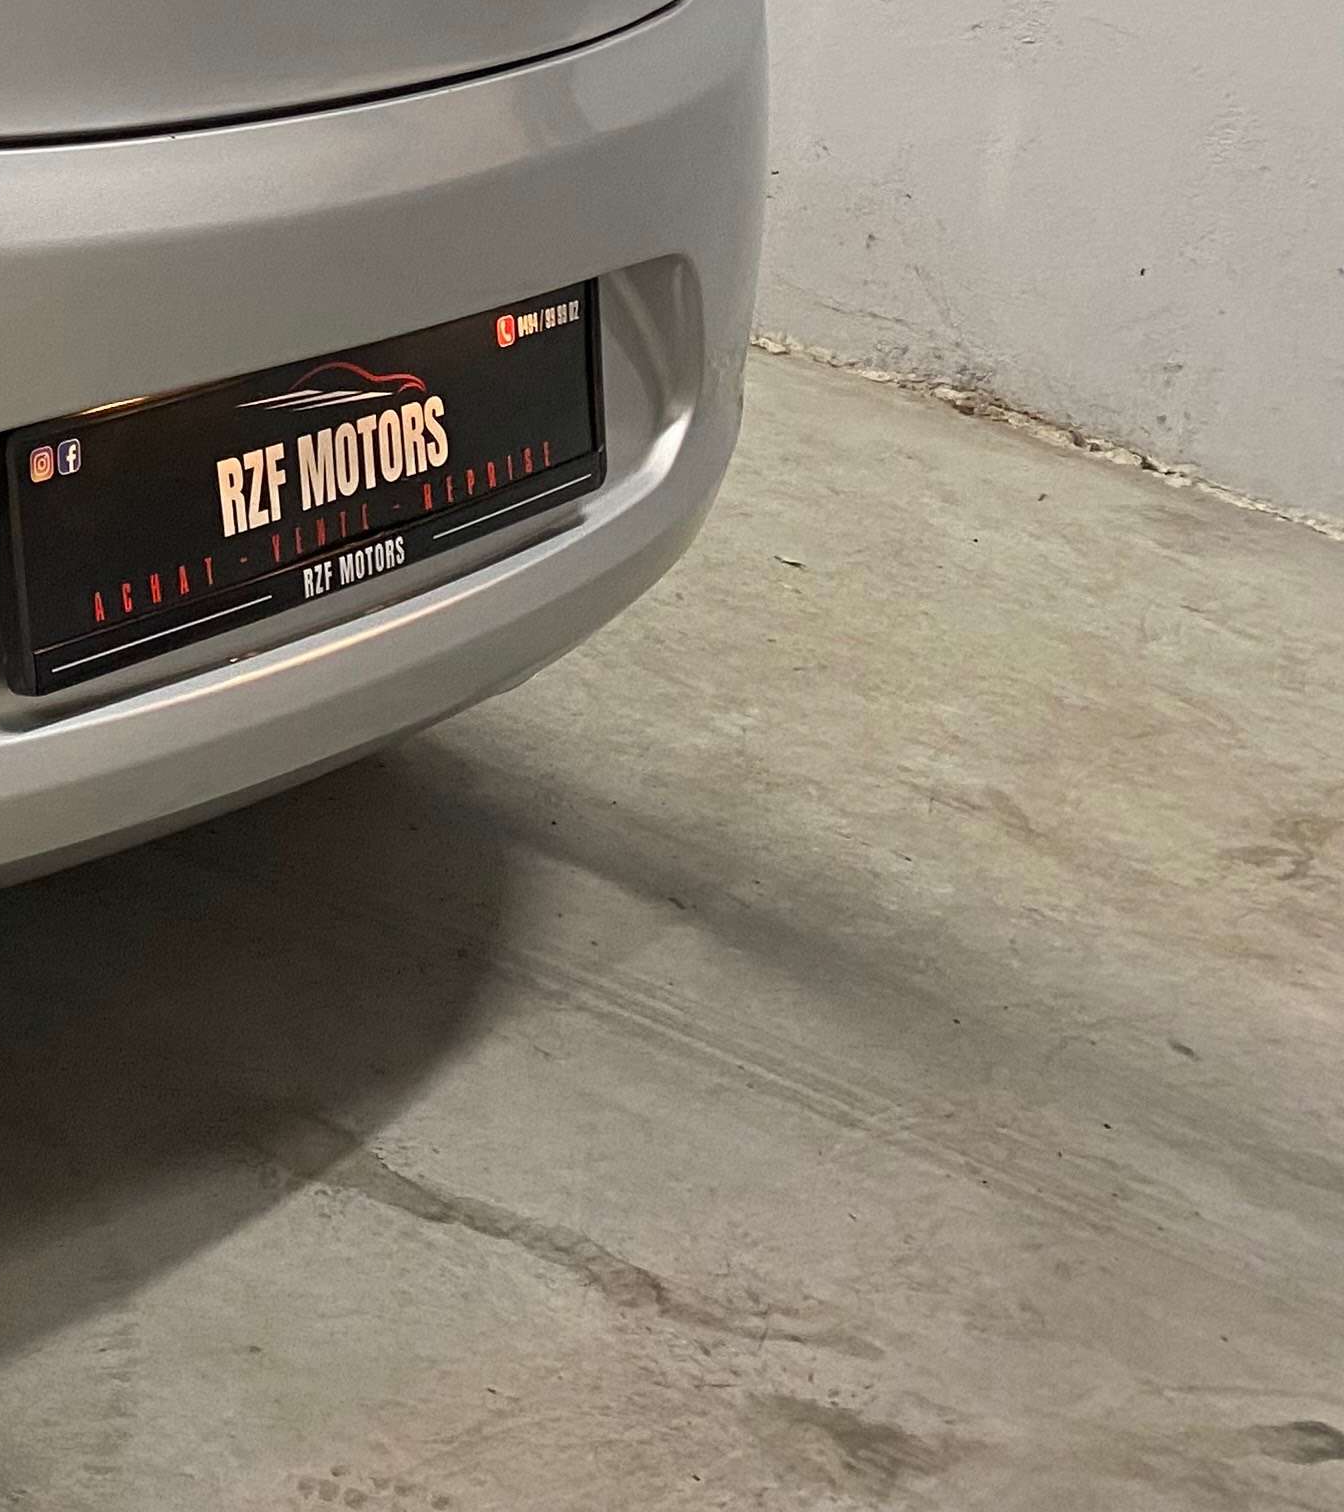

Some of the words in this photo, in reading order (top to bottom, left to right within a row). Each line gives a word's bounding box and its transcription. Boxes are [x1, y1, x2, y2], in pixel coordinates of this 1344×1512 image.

[94, 555, 215, 623] ACHAT
[270, 502, 371, 564] VENTE
[421, 439, 552, 512] REPRISE
[216, 442, 287, 538] RZF
[297, 394, 449, 512] MOTORS
[302, 560, 334, 600] RZF
[338, 535, 406, 587] MOTORS
